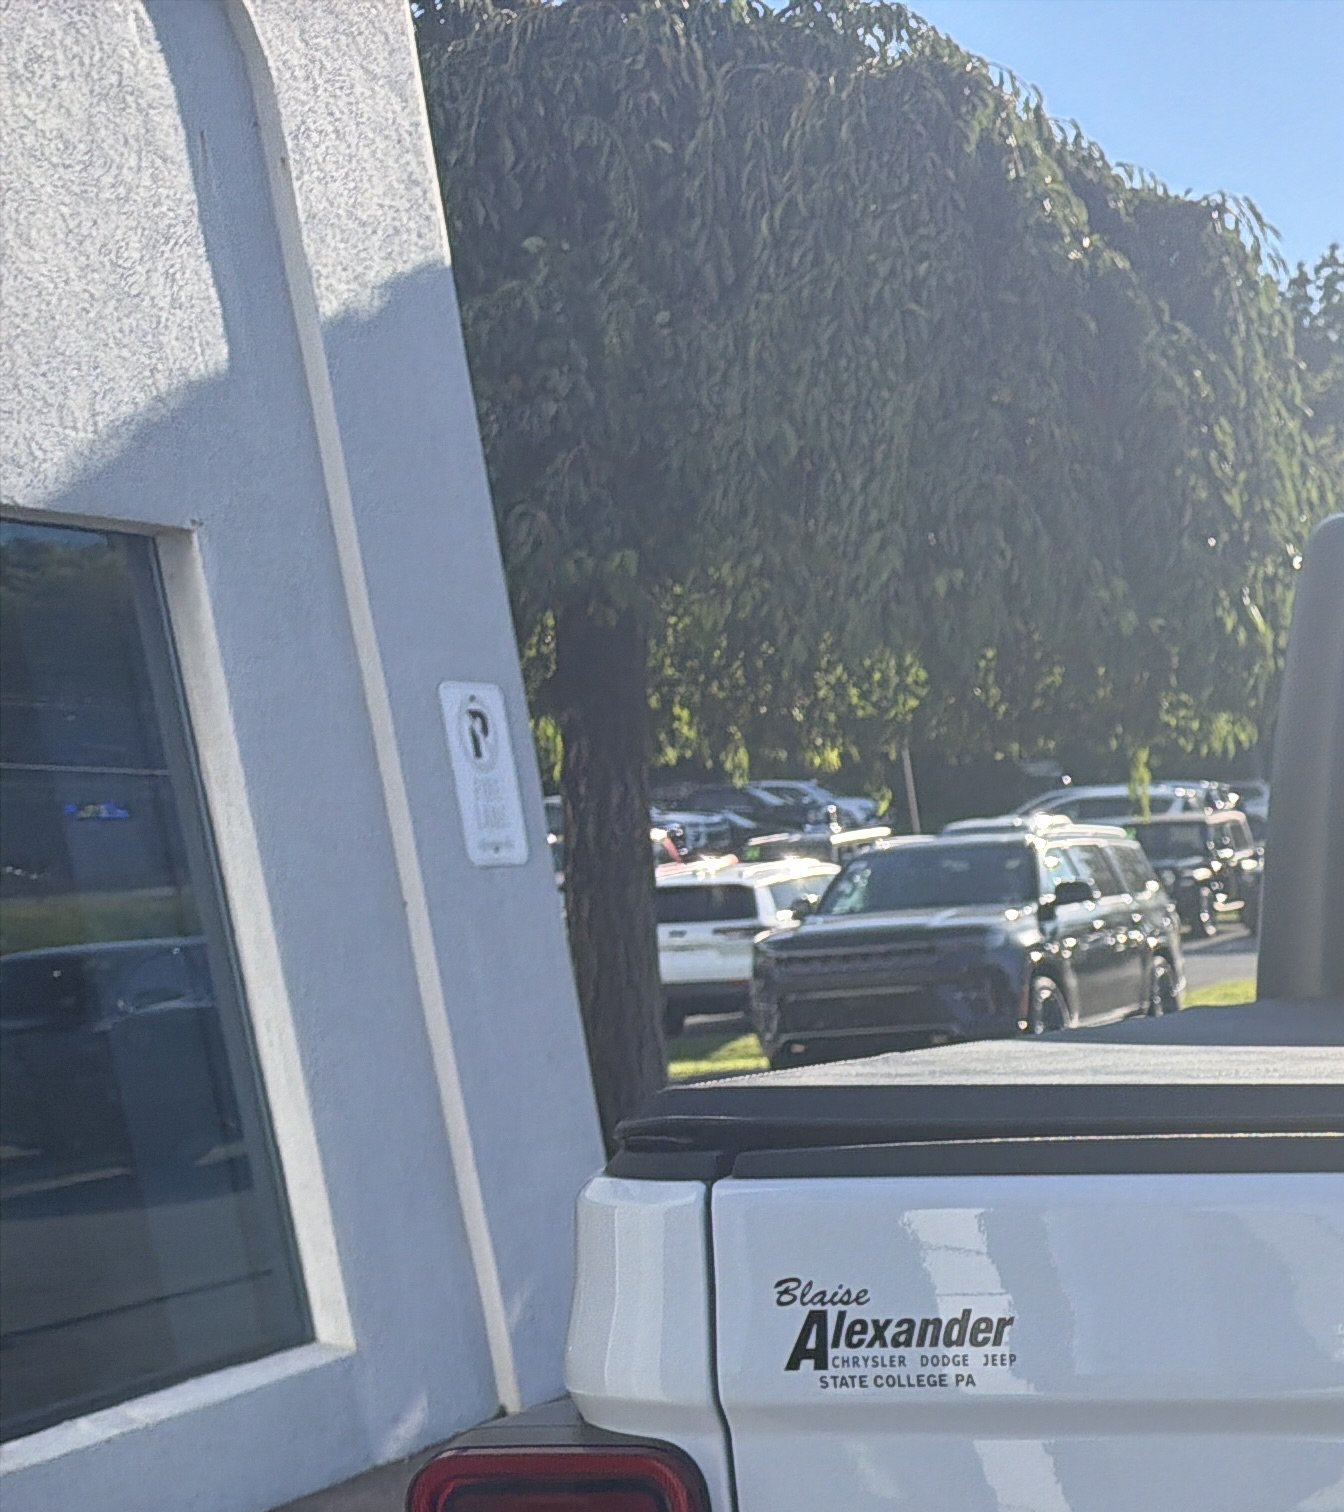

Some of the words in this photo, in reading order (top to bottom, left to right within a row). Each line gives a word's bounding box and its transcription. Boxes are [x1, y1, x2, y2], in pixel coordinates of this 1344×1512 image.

[773, 1276, 871, 1307] Blaise
[784, 1308, 1015, 1371] Alexander
[831, 1355, 907, 1369] CHRYSLER
[920, 1354, 969, 1368] DODGE
[983, 1353, 1017, 1367] JEEP
[819, 1375, 869, 1389] STATE
[873, 1374, 948, 1388] COLLEGE
[955, 1373, 976, 1387] PA
